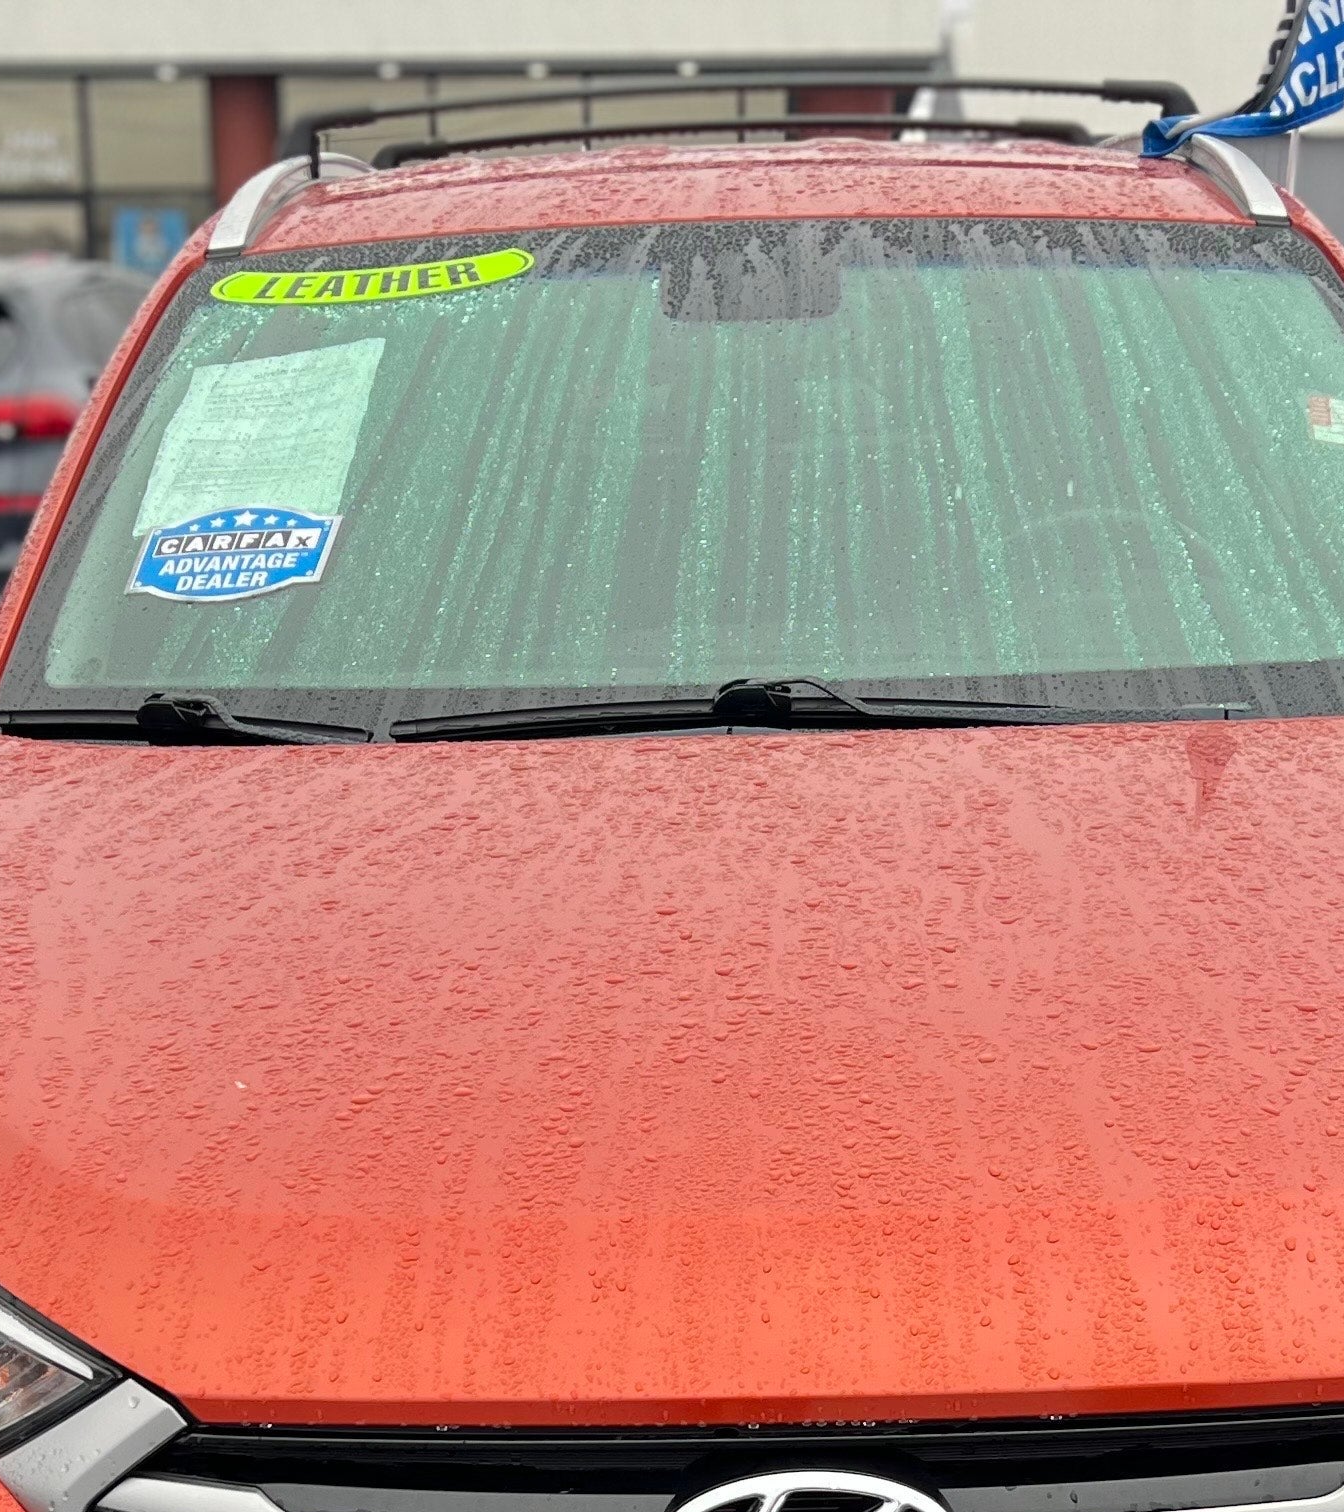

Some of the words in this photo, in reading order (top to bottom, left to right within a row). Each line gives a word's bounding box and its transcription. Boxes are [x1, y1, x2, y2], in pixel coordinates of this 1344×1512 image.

[253, 262, 480, 299] LEATHER
[159, 530, 314, 554] CARFAX
[159, 552, 299, 576] ADVANTAGE
[175, 571, 269, 592] DEALER
